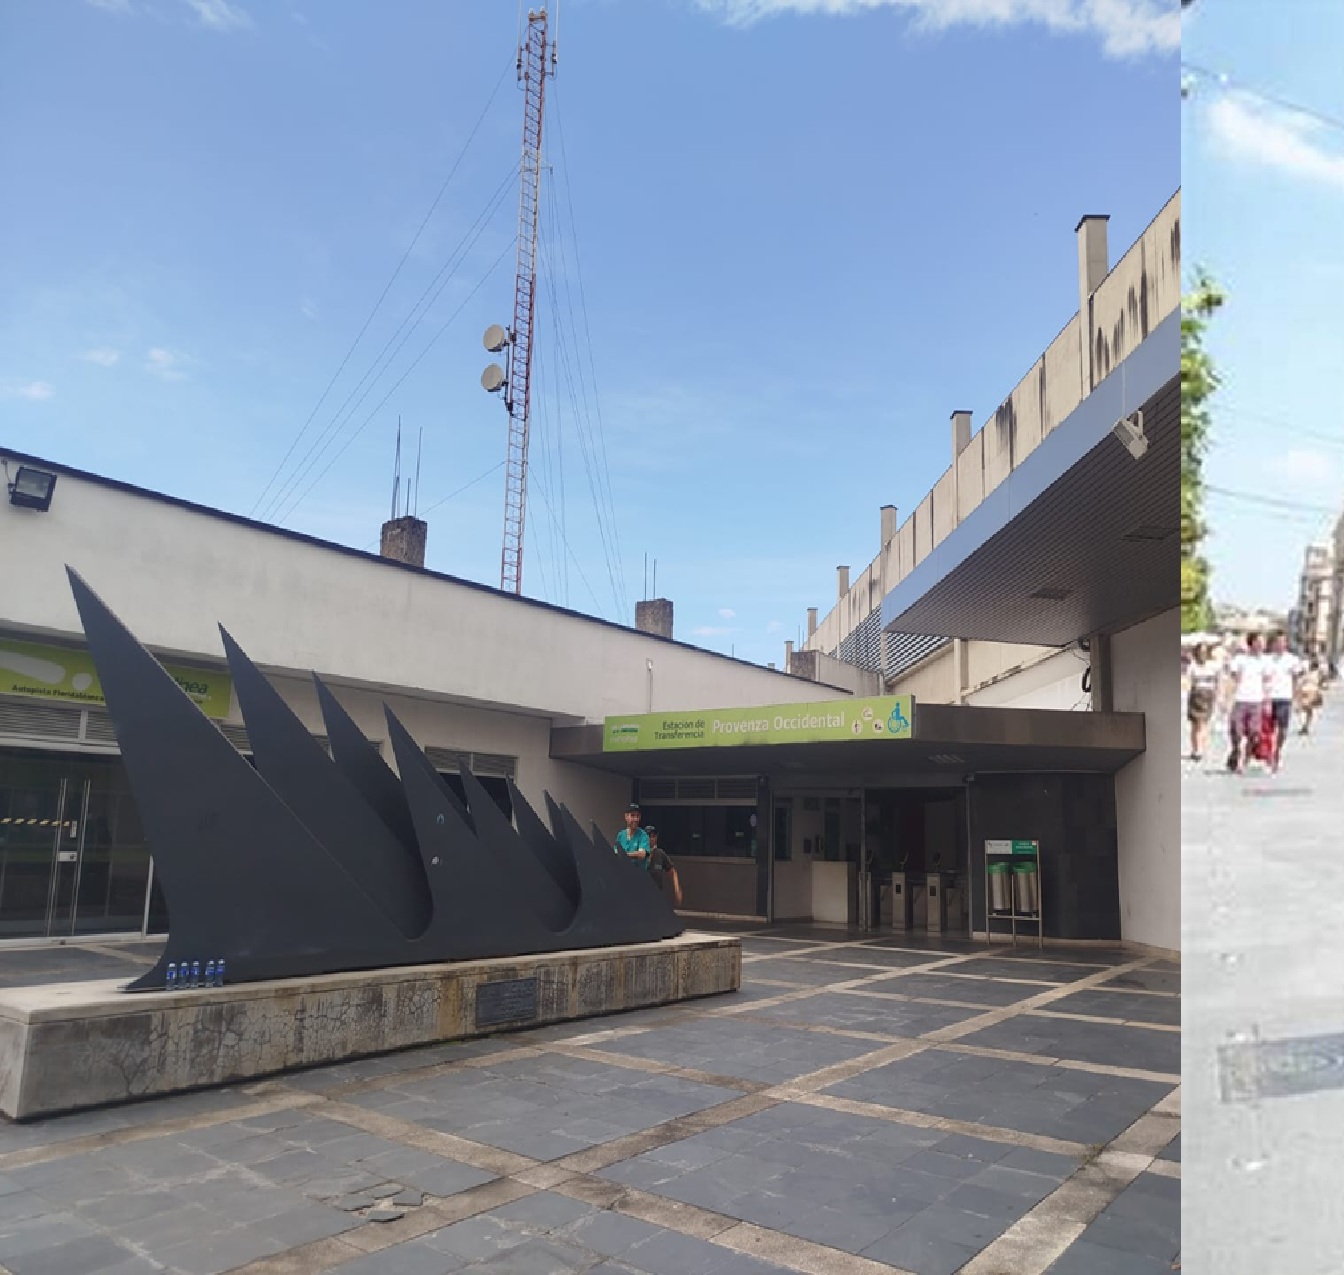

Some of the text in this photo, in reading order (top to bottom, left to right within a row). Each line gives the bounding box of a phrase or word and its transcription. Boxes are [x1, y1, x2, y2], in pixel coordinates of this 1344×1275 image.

[662, 718, 706, 731] Estación de
[712, 711, 845, 734] Provenza Occidental
[654, 730, 705, 740] Transferencia
